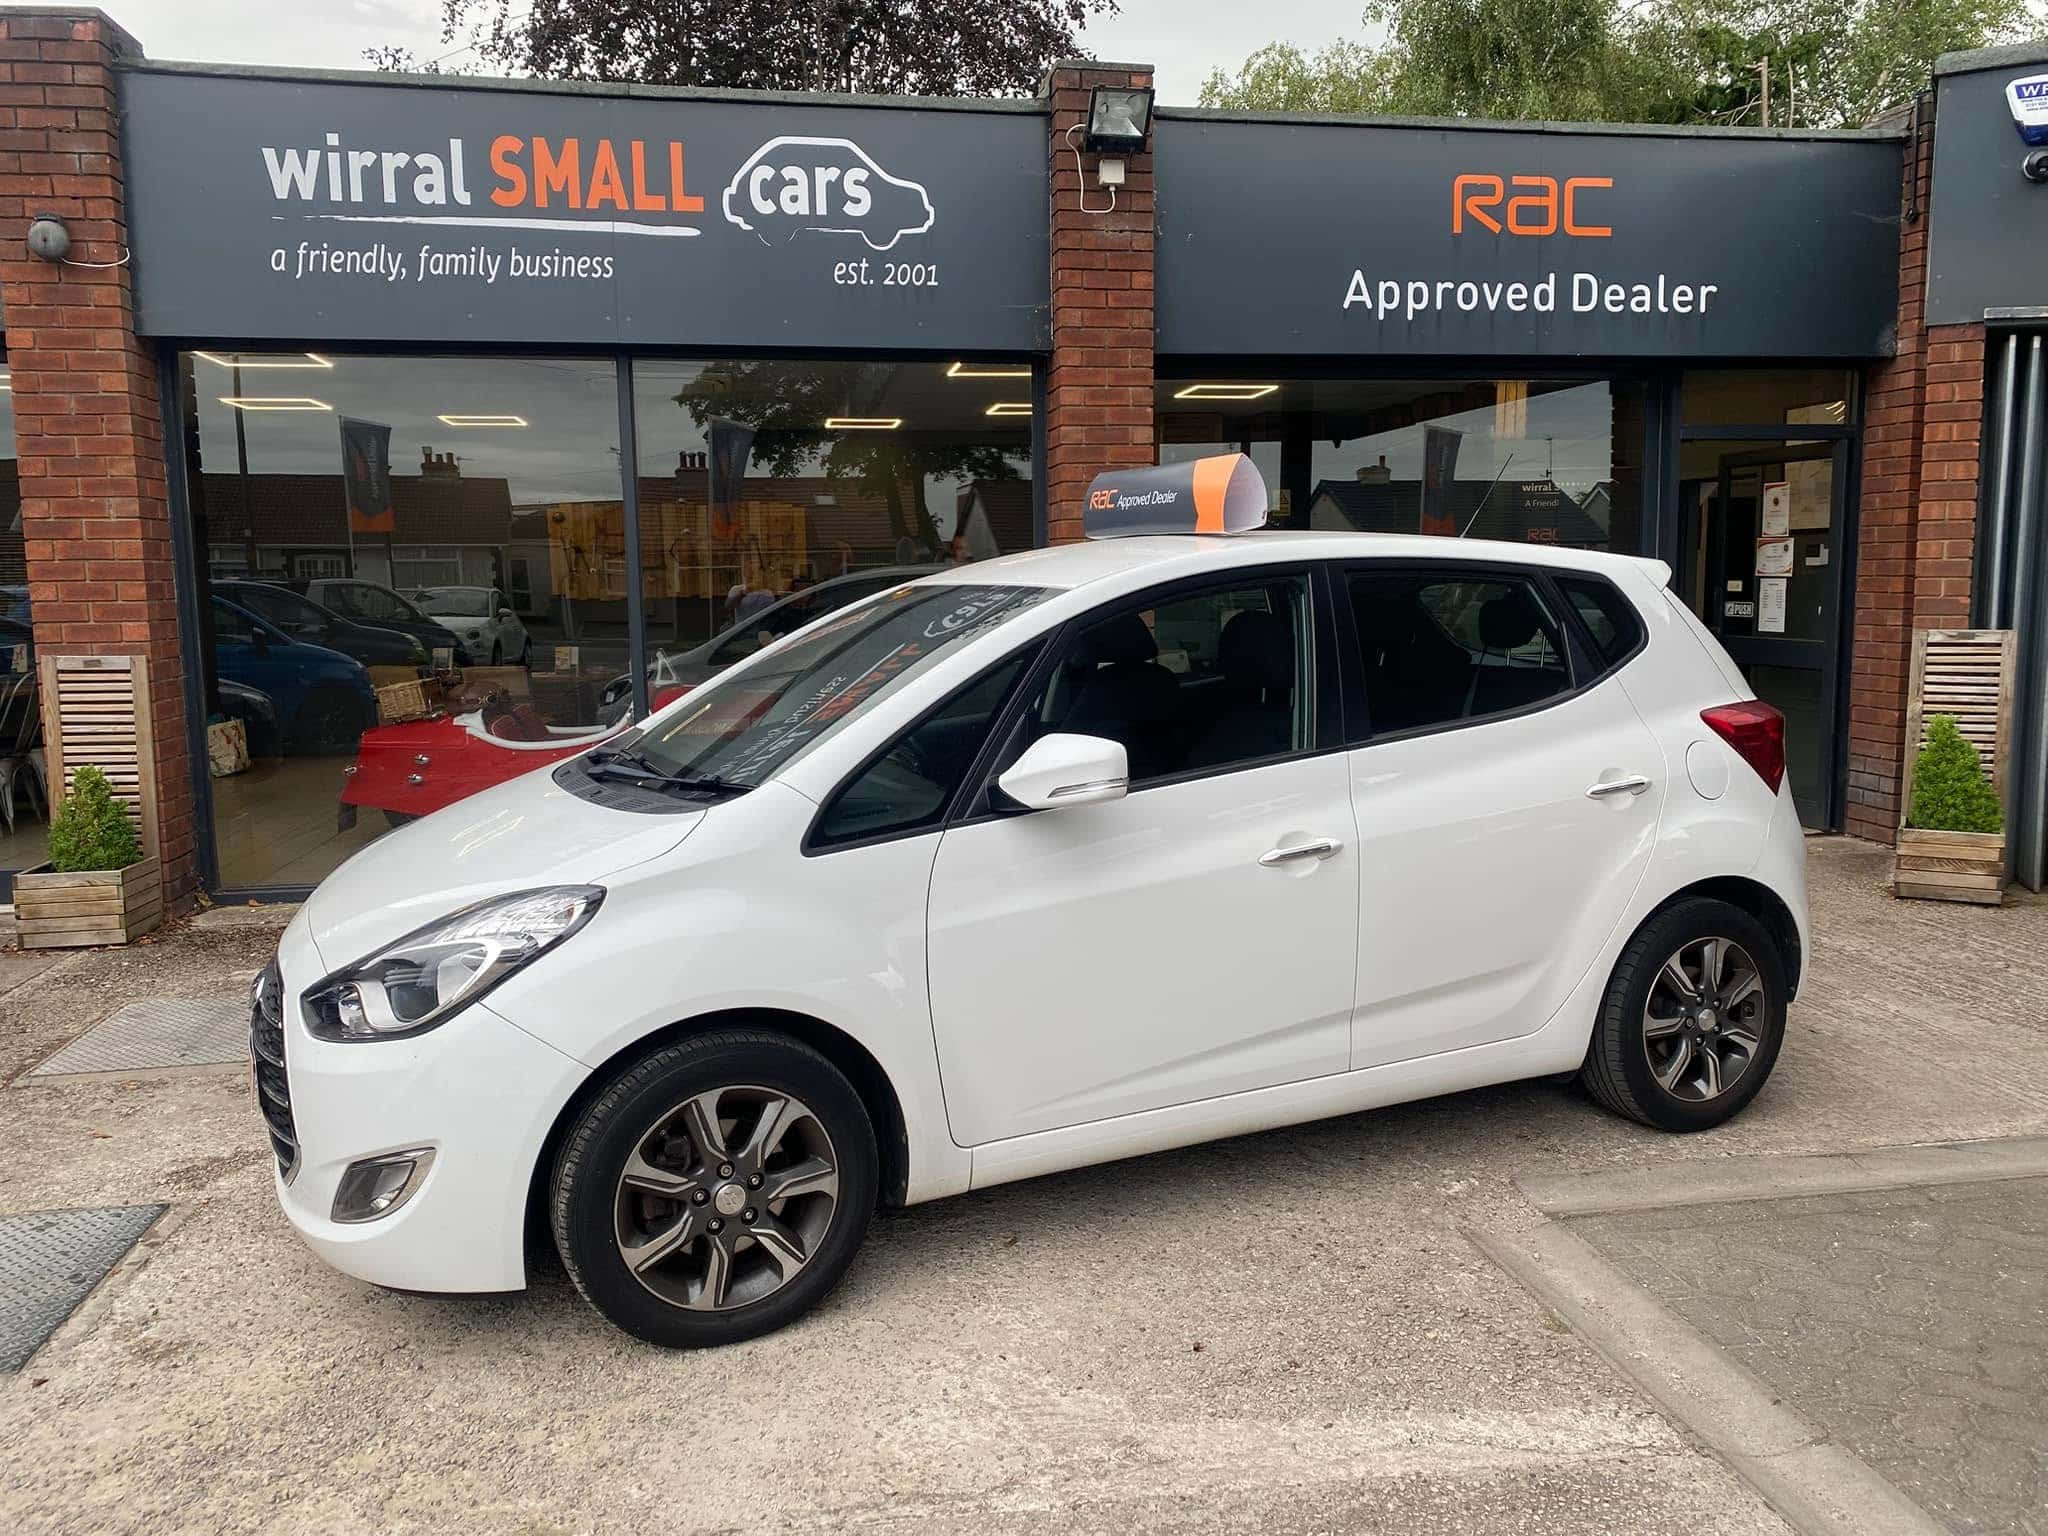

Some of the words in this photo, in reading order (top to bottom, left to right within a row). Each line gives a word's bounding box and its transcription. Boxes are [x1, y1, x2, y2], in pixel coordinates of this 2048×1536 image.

[261, 133, 472, 206] wirral
[490, 135, 705, 212] SMALL
[750, 160, 873, 218] cars
[270, 249, 286, 273] a
[294, 241, 407, 282] friendly,
[415, 244, 502, 284] family
[509, 246, 614, 280] business
[833, 261, 874, 286] est.
[883, 263, 939, 287] 2001
[1342, 270, 1556, 321] Approved
[1572, 273, 1718, 314] Dealer
[1116, 490, 1151, 510] Approved
[1152, 489, 1178, 504] Dealer
